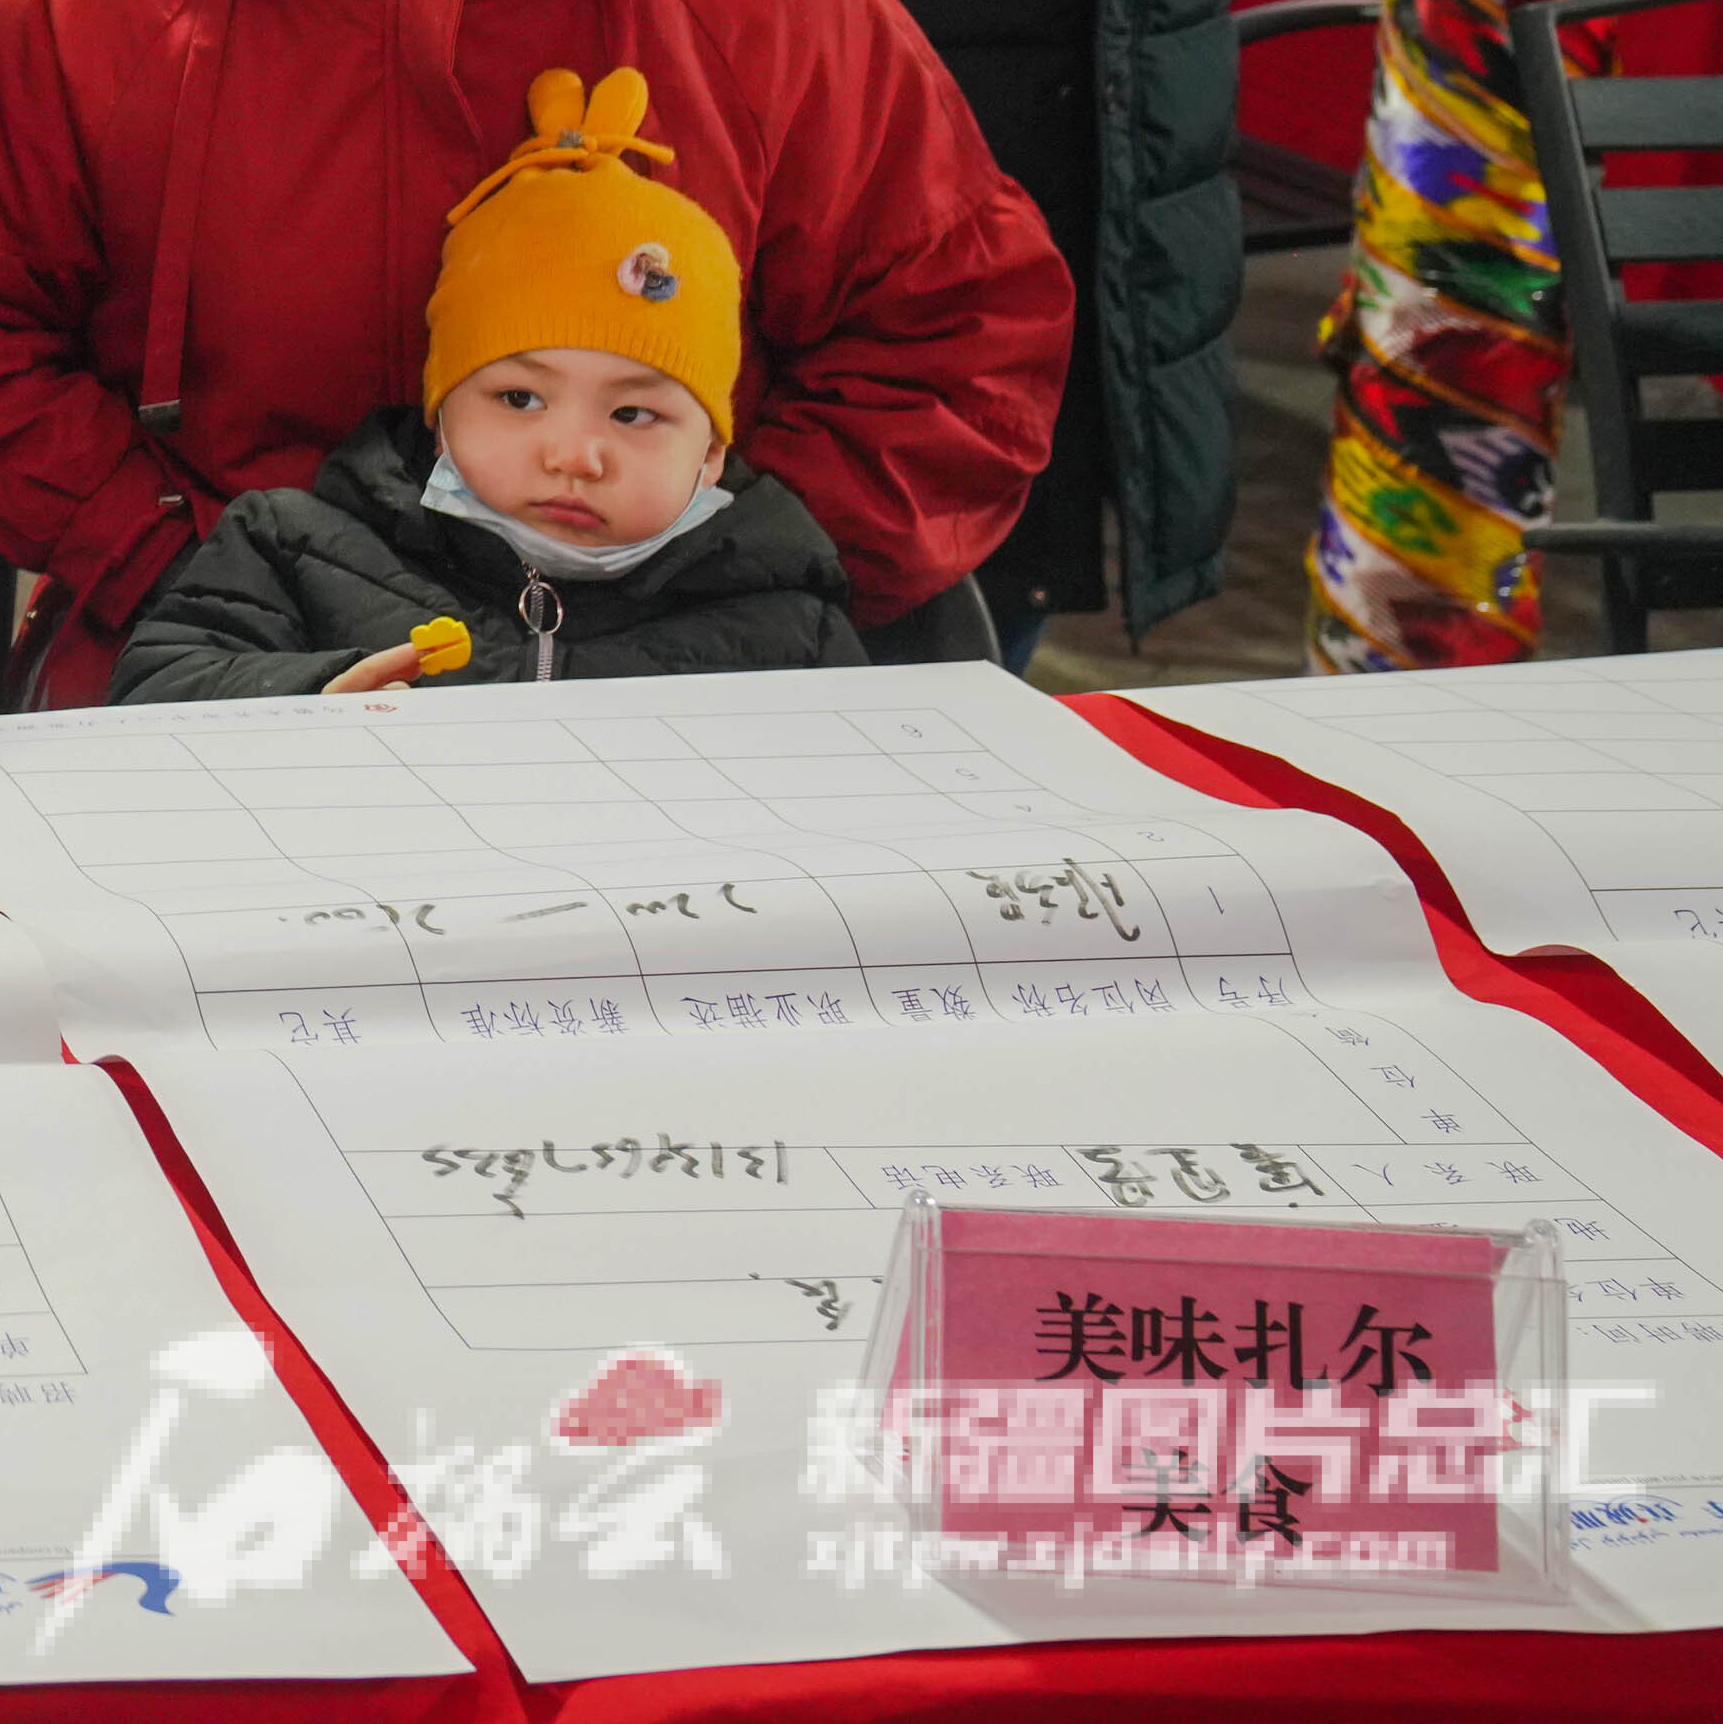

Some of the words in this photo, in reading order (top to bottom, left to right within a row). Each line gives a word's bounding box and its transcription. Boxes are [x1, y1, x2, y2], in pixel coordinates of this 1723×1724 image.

[889, 985, 972, 1023] 数量
[1010, 978, 1169, 1019] 岗位名称
[1216, 974, 1288, 1010] 序号
[278, 1007, 358, 1047] 其它
[460, 997, 628, 1041] 薪资标准
[677, 991, 843, 1034] 职业描述
[879, 1163, 1058, 1191] 联系电话
[1351, 1159, 1535, 1187] 联系人
[1034, 1291, 1433, 1397] 美味扎尔
[1119, 1448, 1316, 1548] 美食
